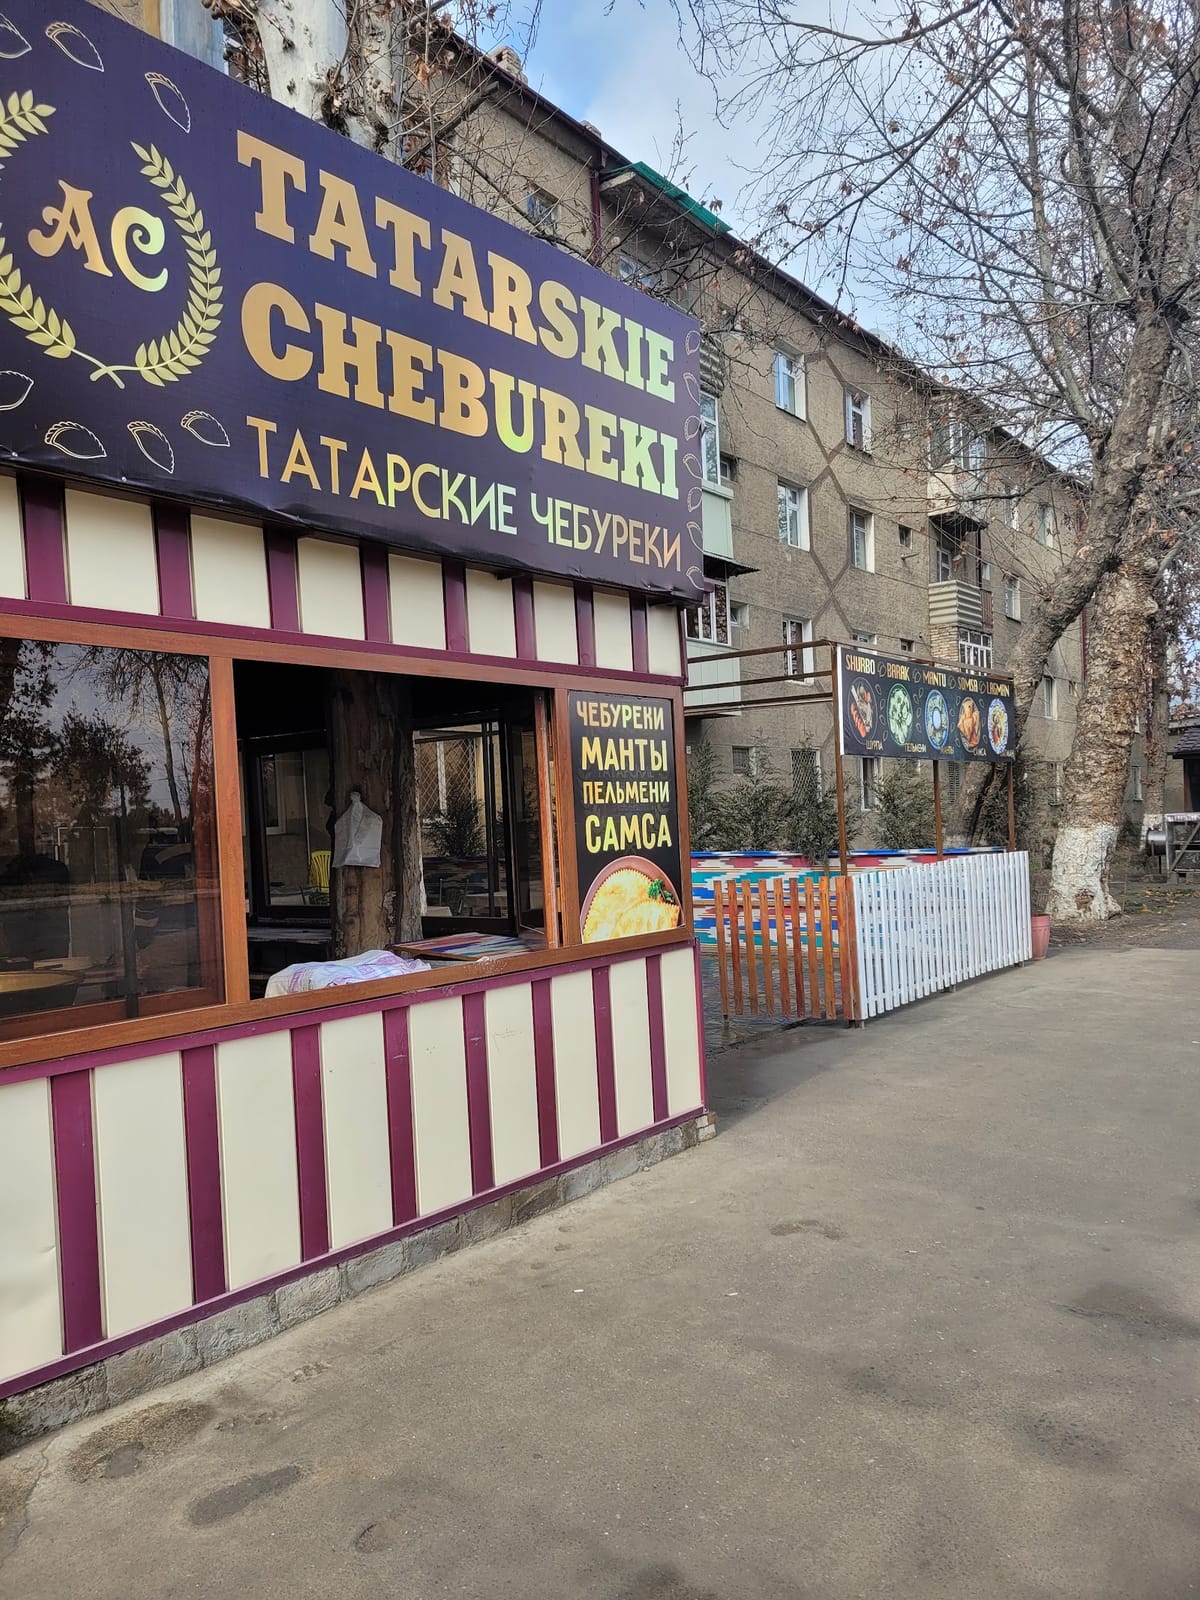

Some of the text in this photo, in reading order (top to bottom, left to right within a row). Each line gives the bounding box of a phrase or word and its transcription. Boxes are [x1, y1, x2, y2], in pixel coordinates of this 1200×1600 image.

[236, 129, 676, 403] TATARSKIE
[241, 281, 680, 500] CHEBUREKI
[246, 415, 682, 572] ТАТАРСКИЕ ЧЕБУРЕКИ
[845, 654, 876, 675] SHURBO
[886, 662, 911, 682] BARAK
[922, 669, 947, 688] MANTU
[576, 700, 665, 731] ЧЕБУРЕКИ
[581, 736, 668, 772] МАНТЫ
[582, 781, 670, 805] ПЕЛЬМЕНИ
[585, 812, 673, 855] САМСА
